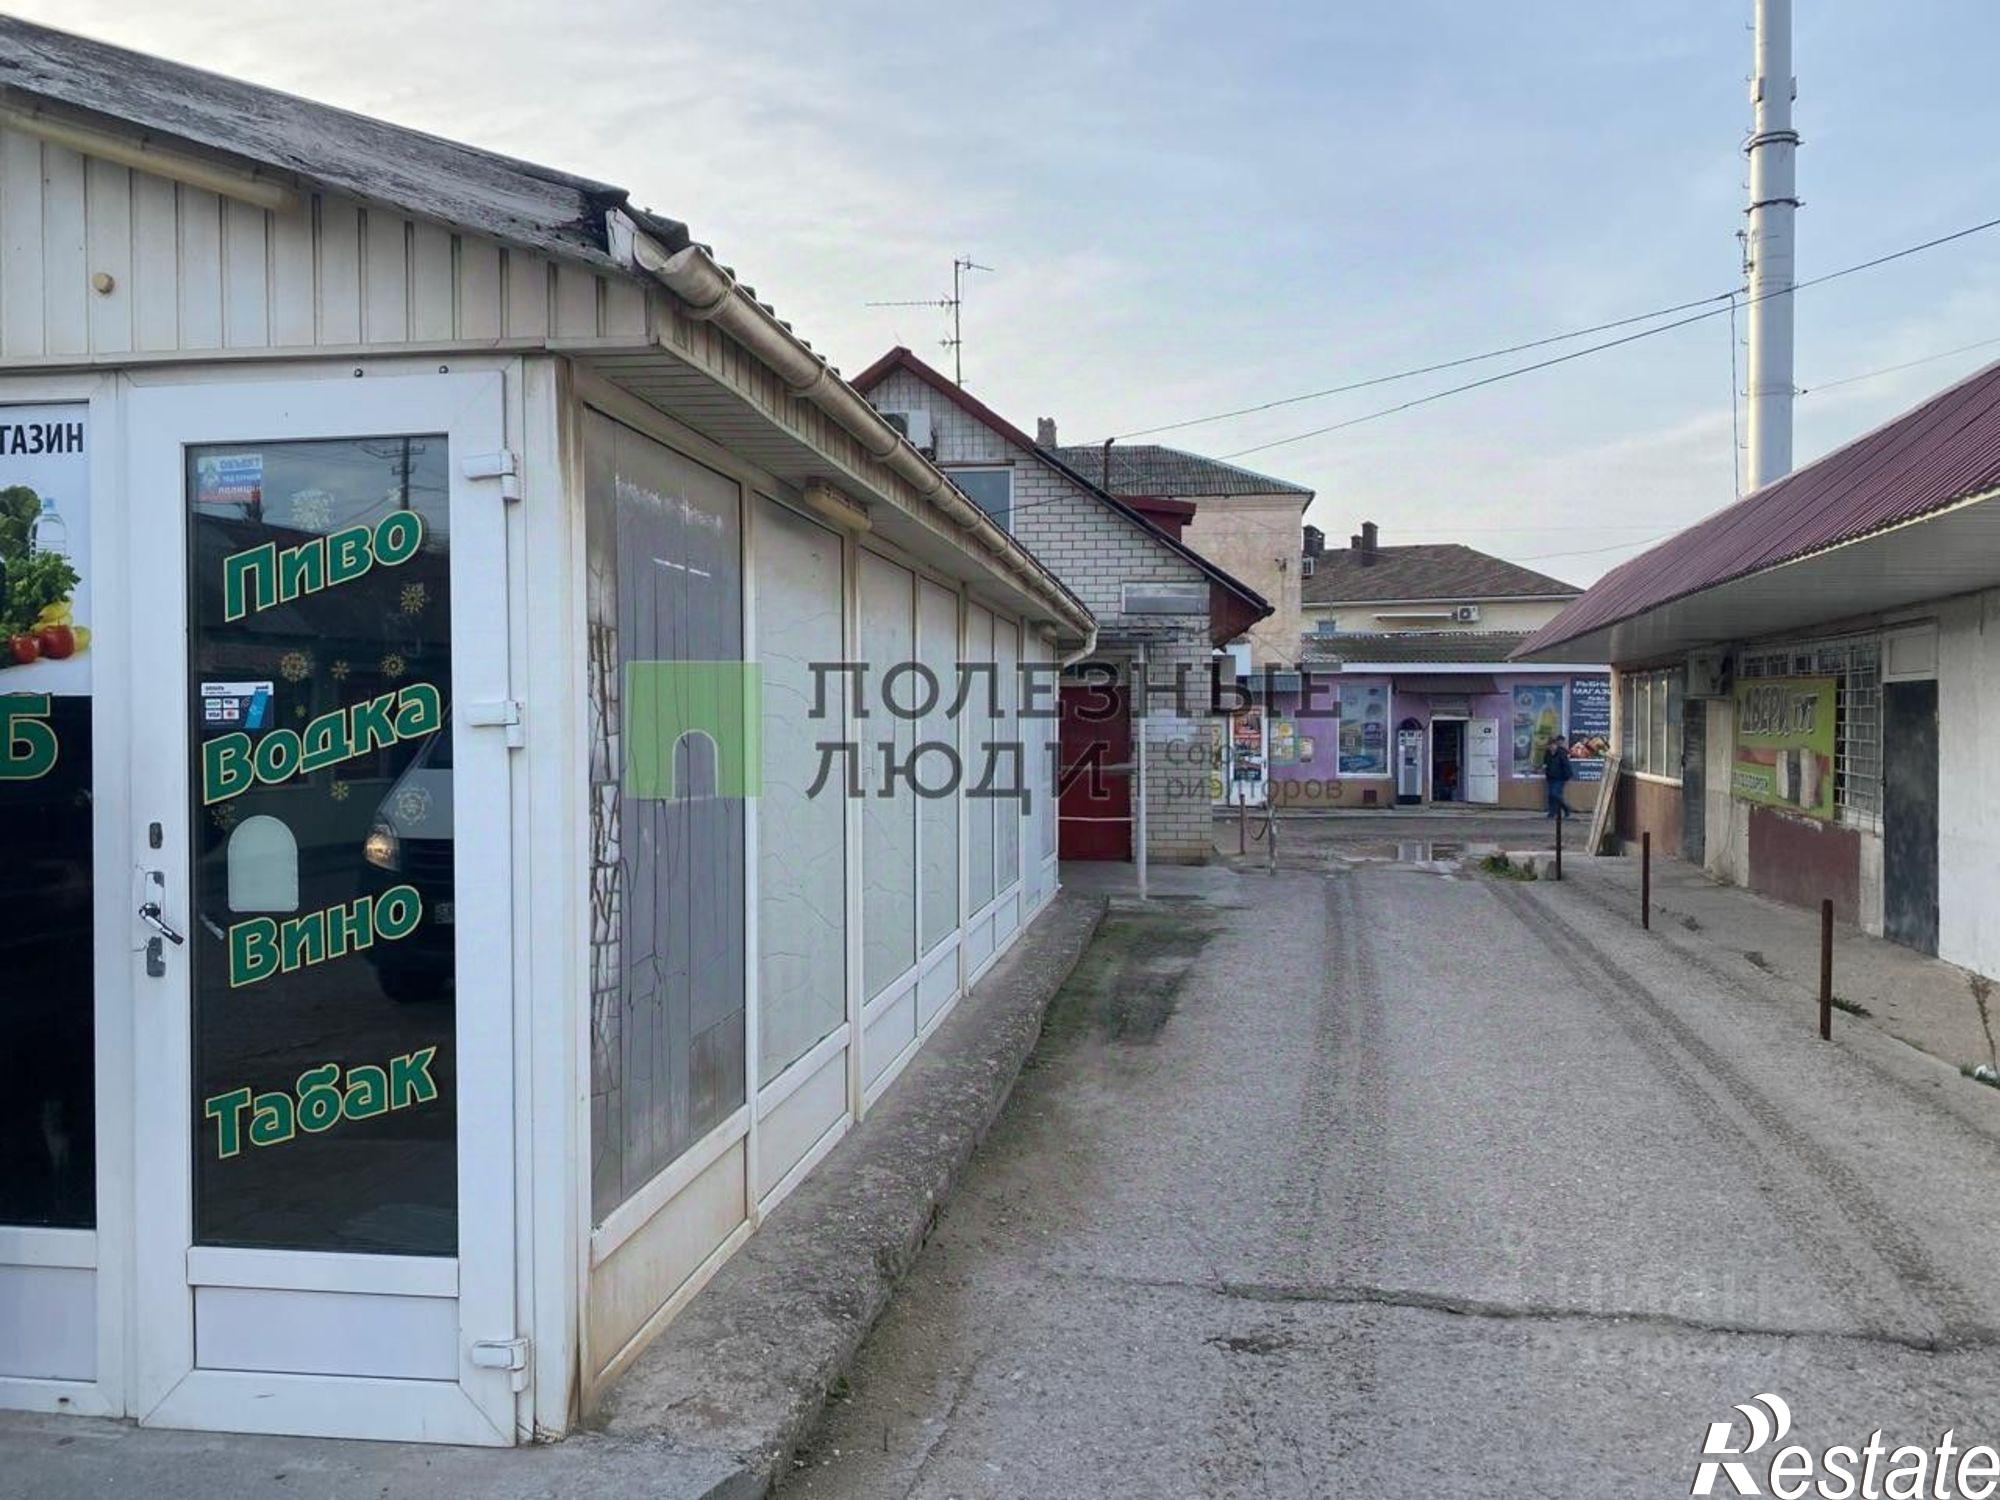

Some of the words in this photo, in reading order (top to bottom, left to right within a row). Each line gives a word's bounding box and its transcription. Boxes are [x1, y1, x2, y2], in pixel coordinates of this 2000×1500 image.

[224, 509, 423, 622] Пиво
[203, 683, 441, 805] Водка
[229, 885, 422, 988] Вино
[206, 1046, 438, 1159] Табак
